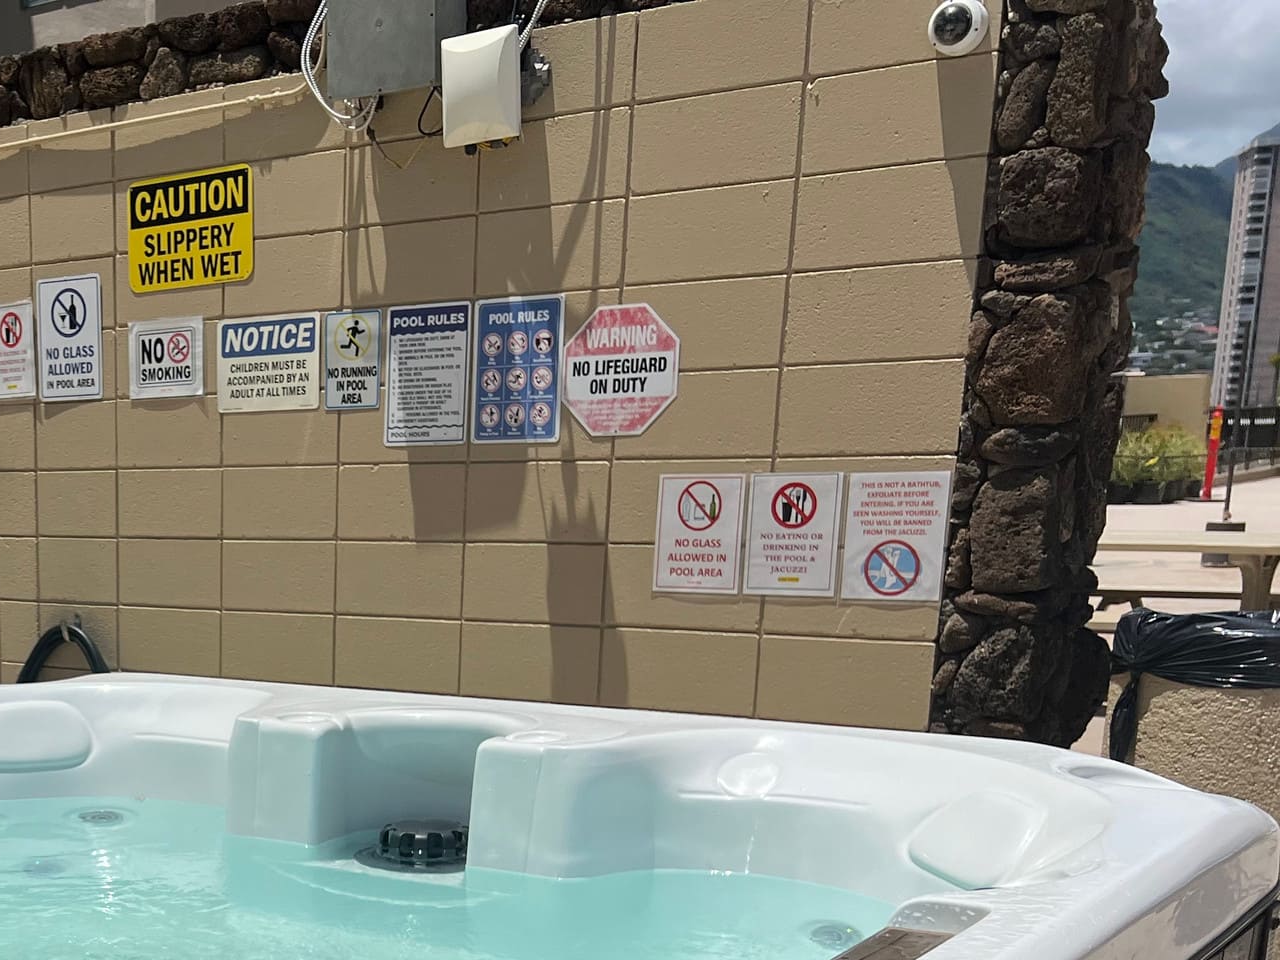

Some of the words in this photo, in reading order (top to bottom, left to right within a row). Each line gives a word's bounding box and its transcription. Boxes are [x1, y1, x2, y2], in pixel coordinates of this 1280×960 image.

[135, 175, 243, 222] CAUTION
[144, 222, 234, 257] SLIPPERY
[138, 257, 193, 286] WHEN
[201, 250, 242, 278] WET
[393, 316, 424, 328] POOL
[427, 313, 465, 326] RULES
[489, 313, 515, 325] POOL
[517, 310, 549, 323] RULES
[224, 322, 313, 353] NOTICE
[586, 324, 657, 349] WARNING
[46, 348, 59, 360] NO
[63, 345, 94, 359] GLASS
[141, 337, 164, 365] NO
[48, 362, 93, 376] ALLOWED
[230, 361, 269, 373] CHILDREN
[271, 360, 294, 371] MUST
[296, 359, 307, 369] BE
[328, 368, 339, 379] NO
[341, 366, 377, 378] RUNNING
[573, 361, 590, 376] NO
[595, 356, 667, 376] LIFEGUARD
[141, 365, 191, 382] SMOKING
[227, 374, 284, 386] ACCOMPANIED
[286, 373, 297, 383] BY
[299, 372, 309, 382] AN
[47, 381, 54, 390] IN
[56, 380, 75, 389] POOL
[77, 378, 95, 387] AREA
[336, 380, 345, 391] IN
[347, 380, 367, 391] POOL
[590, 379, 607, 394] ON
[613, 377, 647, 393] DUTY
[230, 388, 254, 399] ADULT
[255, 387, 265, 397] AT
[266, 387, 280, 397] ALL
[281, 386, 306, 396] TIMES
[341, 393, 362, 404] AREA
[675, 539, 689, 548] NO
[692, 539, 721, 548] GLASS
[667, 553, 713, 562] ALLOWED
[717, 553, 727, 562] IN
[670, 567, 695, 576] POOL
[697, 568, 722, 576] AREA
[770, 566, 807, 574] JACUZZI
